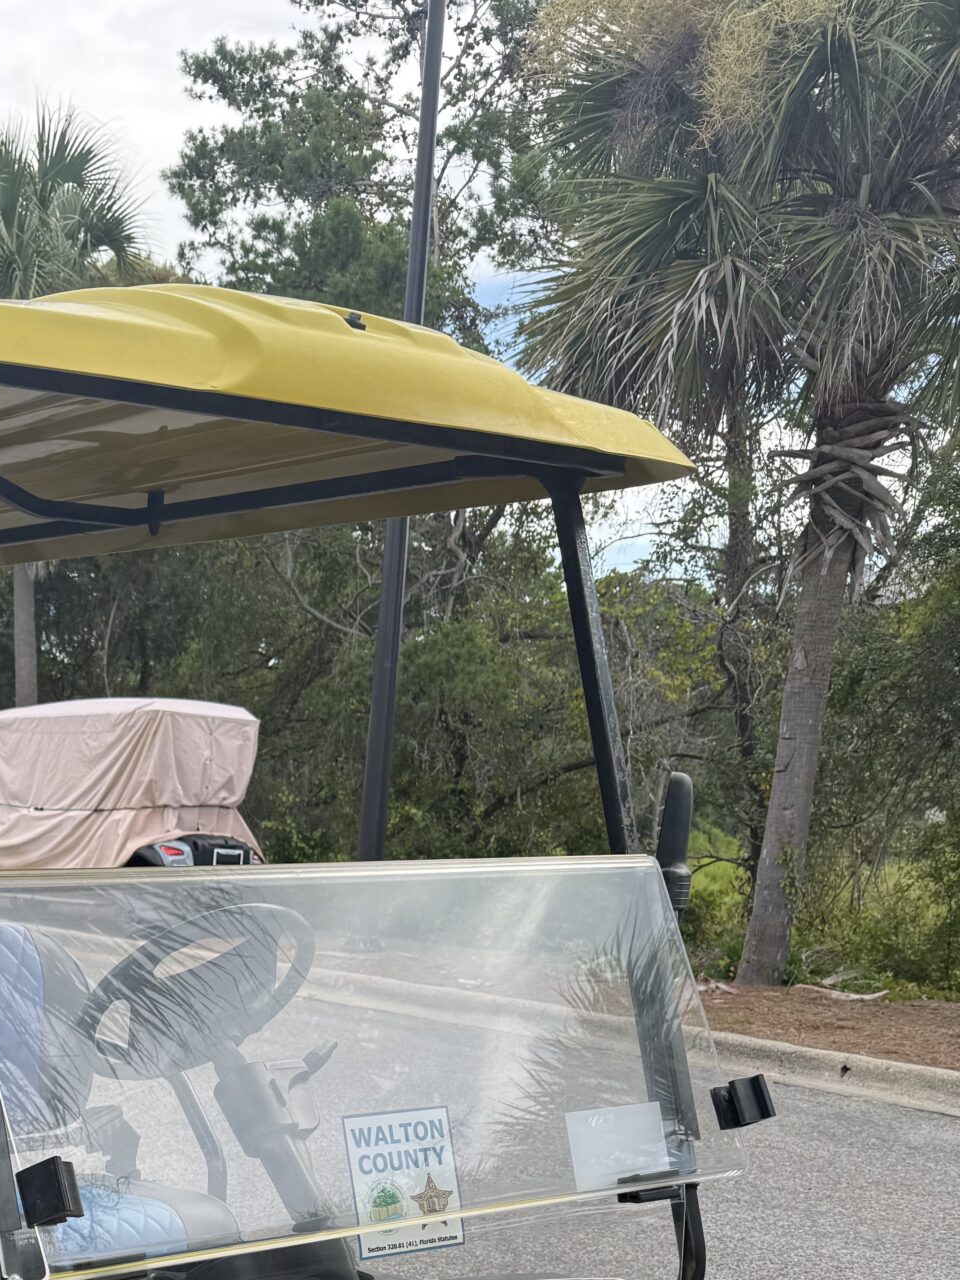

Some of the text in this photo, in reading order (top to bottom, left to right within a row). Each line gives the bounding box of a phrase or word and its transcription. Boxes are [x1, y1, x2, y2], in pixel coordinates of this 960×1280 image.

[350, 1118, 445, 1149] WALTON
[358, 1145, 445, 1175] COUNTY
[420, 1238, 437, 1246] Florida
[437, 1235, 458, 1243] Statutes
